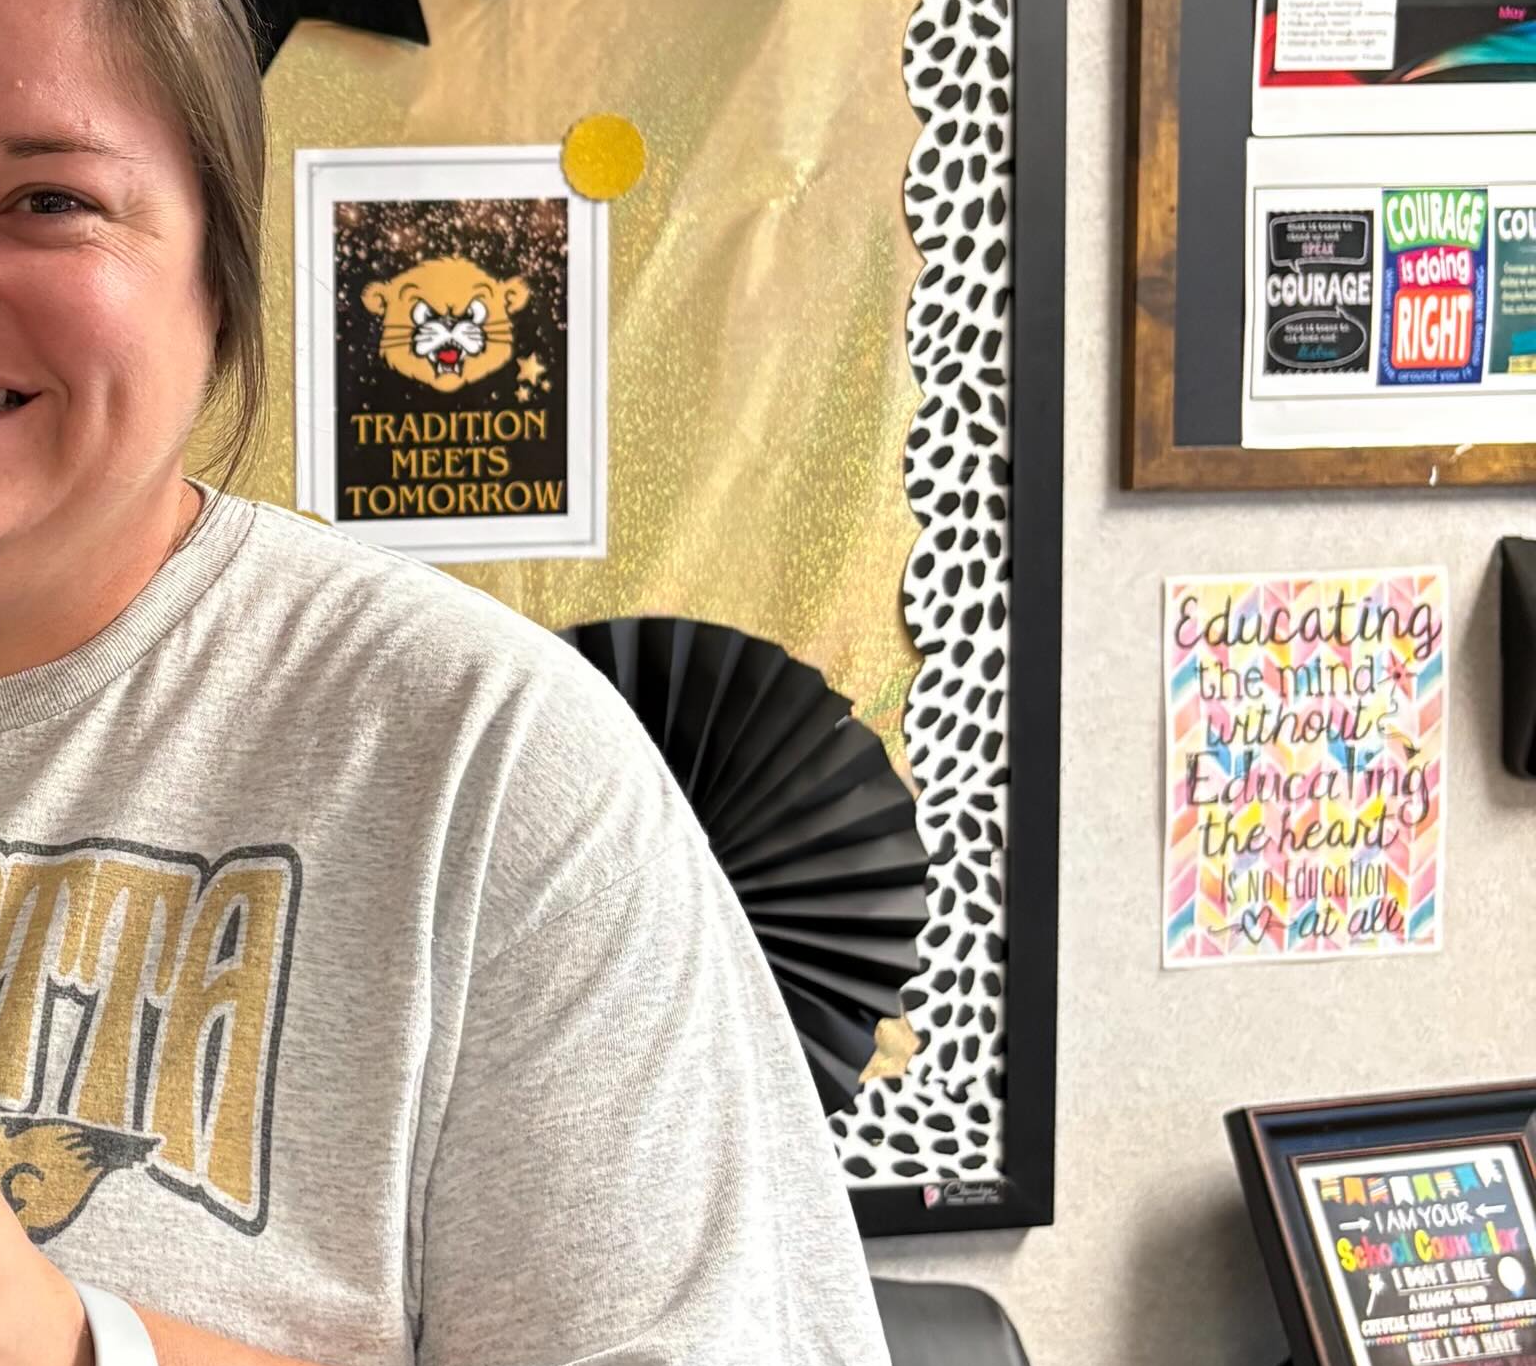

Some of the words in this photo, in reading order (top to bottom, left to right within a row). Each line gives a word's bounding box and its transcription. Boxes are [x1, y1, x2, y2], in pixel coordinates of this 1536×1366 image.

[1387, 191, 1484, 244] COURAGE
[1267, 272, 1371, 307] COURAGE
[1401, 256, 1414, 283] is
[1416, 248, 1471, 286] doing
[1396, 294, 1473, 363] RIGHT
[350, 408, 548, 445] TRADITION
[390, 446, 510, 480] MEETS
[344, 480, 563, 517] TOMORROW
[1174, 589, 1442, 660] Educating
[1197, 660, 1265, 701] the
[1278, 654, 1376, 698] mind
[1206, 700, 1372, 746] without
[1185, 744, 1431, 826] Educating
[1199, 812, 1270, 857] the
[1278, 804, 1399, 851] heart
[1298, 908, 1340, 938] at
[1374, 1212, 1383, 1233] I
[1387, 1208, 1417, 1232] AM
[1417, 1201, 1475, 1228] YOUR
[1337, 1232, 1413, 1273] School
[1414, 1221, 1519, 1262] Counselor
